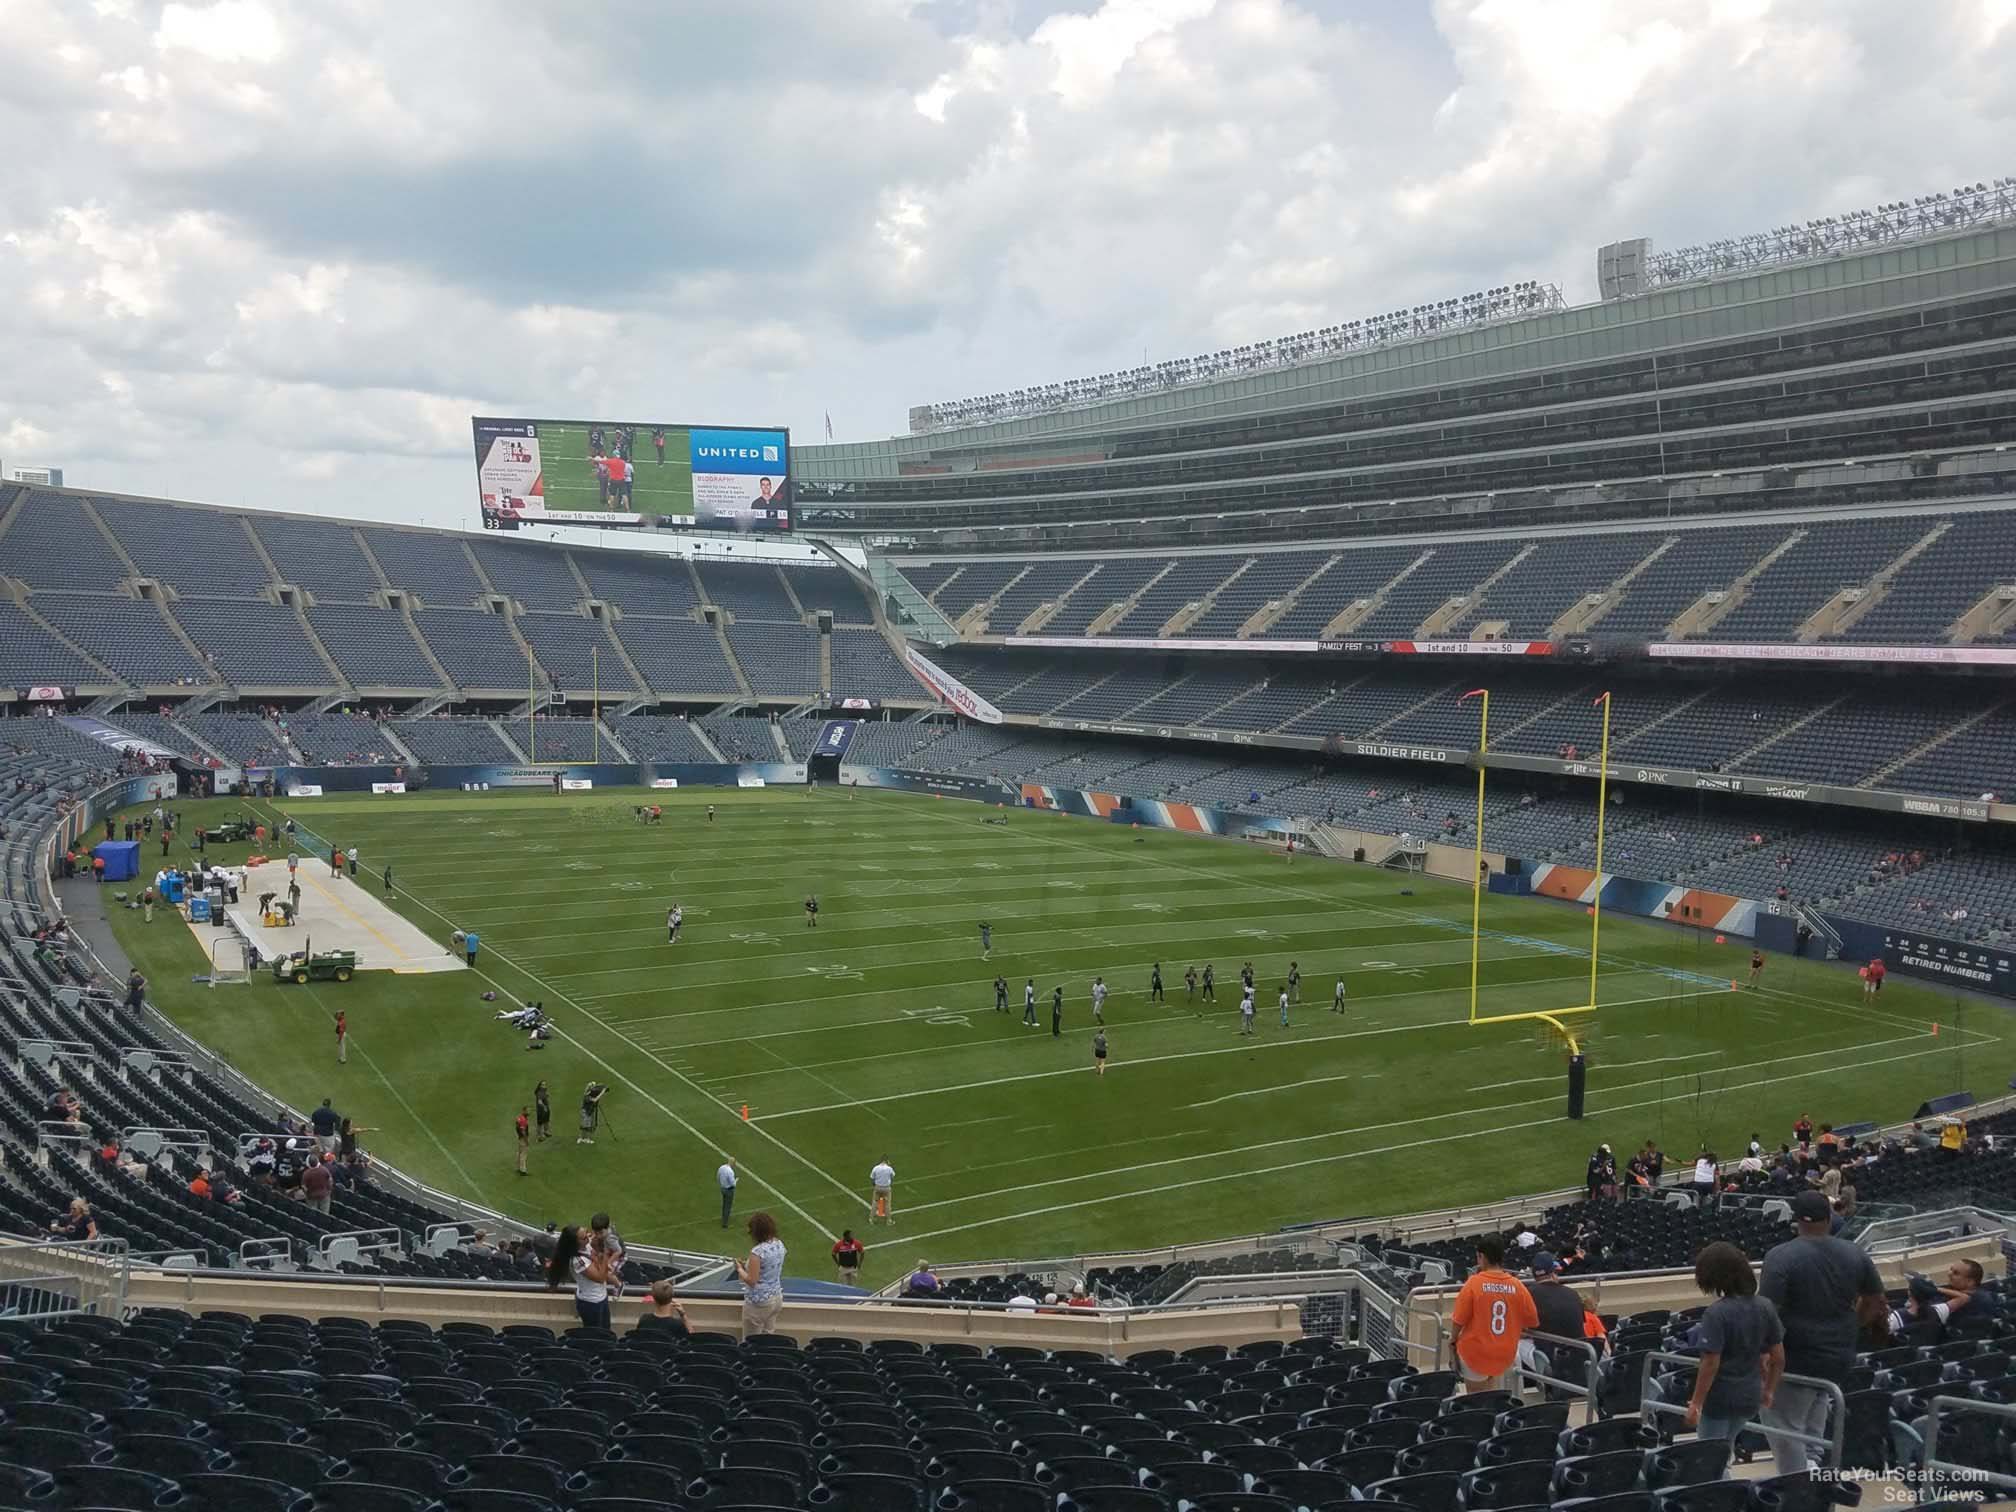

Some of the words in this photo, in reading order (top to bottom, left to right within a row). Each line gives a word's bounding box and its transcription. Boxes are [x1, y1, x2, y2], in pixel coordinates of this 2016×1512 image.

[699, 447, 760, 458] UNITED
[1319, 642, 1343, 651] FAMILY
[1345, 642, 1361, 651] FEST
[1427, 644, 1440, 652] 1st
[1442, 644, 1456, 652] and
[1458, 644, 1468, 652] 10
[1501, 644, 1512, 653] 50
[1358, 745, 1408, 759] SOLDIER
[1411, 749, 1446, 761] FIELD
[1648, 771, 1668, 783] PNC
[1766, 786, 1806, 799] verizon
[1904, 800, 1940, 813] WBBM
[1963, 807, 1986, 817] 105.9
[1902, 955, 1942, 970] RETIRED
[1943, 964, 1993, 981] NUMBERS
[278, 1163, 293, 1177] 52
[1482, 1282, 1516, 1294] GROSSMAN
[1491, 1300, 1507, 1336] 8
